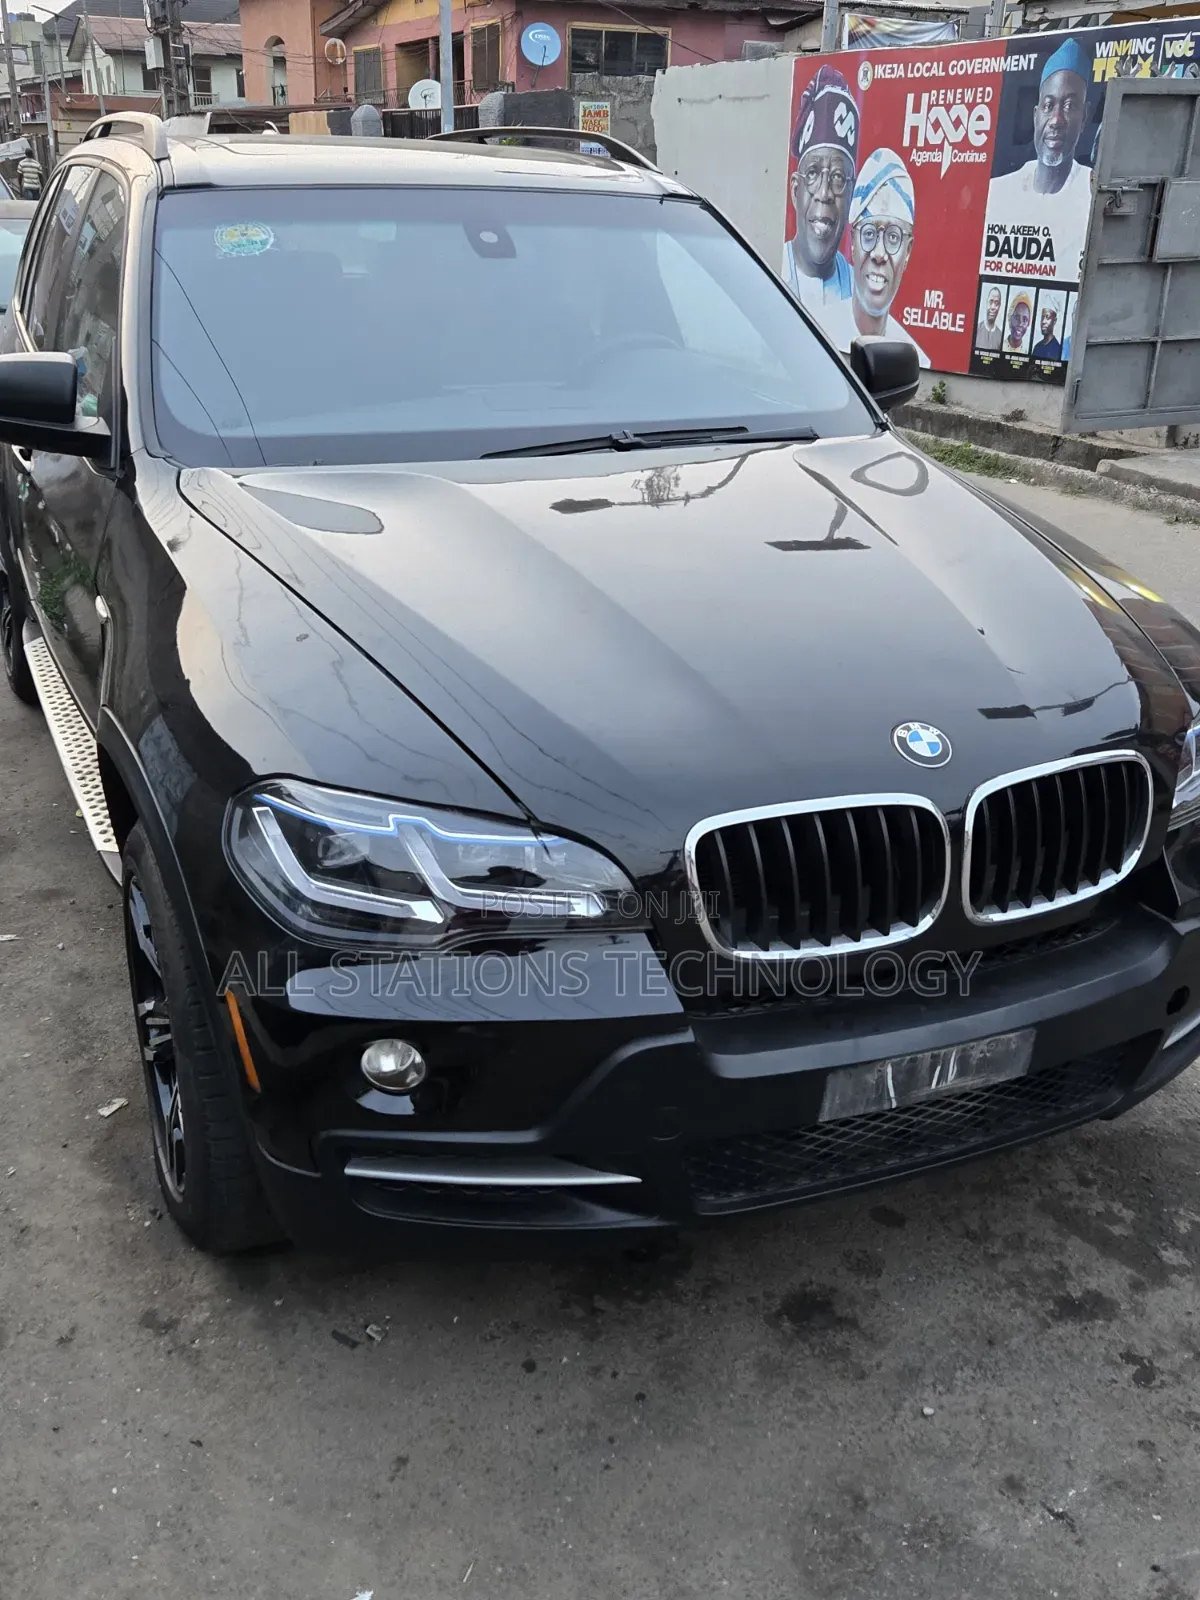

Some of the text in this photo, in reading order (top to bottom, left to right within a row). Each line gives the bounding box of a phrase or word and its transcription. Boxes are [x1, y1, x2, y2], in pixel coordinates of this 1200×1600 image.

[1095, 36, 1156, 58] WINNING
[874, 53, 1038, 79] IKEJA LOCAL GOVERNMENT
[930, 86, 993, 105] RENEWED
[581, 109, 609, 118] JAMB
[910, 148, 987, 167] Agenda Continue
[986, 223, 1008, 235] HON.
[1009, 225, 1040, 237] AKEEM
[985, 234, 1055, 263] DAUDA
[984, 260, 1057, 277] FOR CHAIRMAN
[923, 289, 945, 310] MR.
[902, 306, 966, 333] SELLABLE
